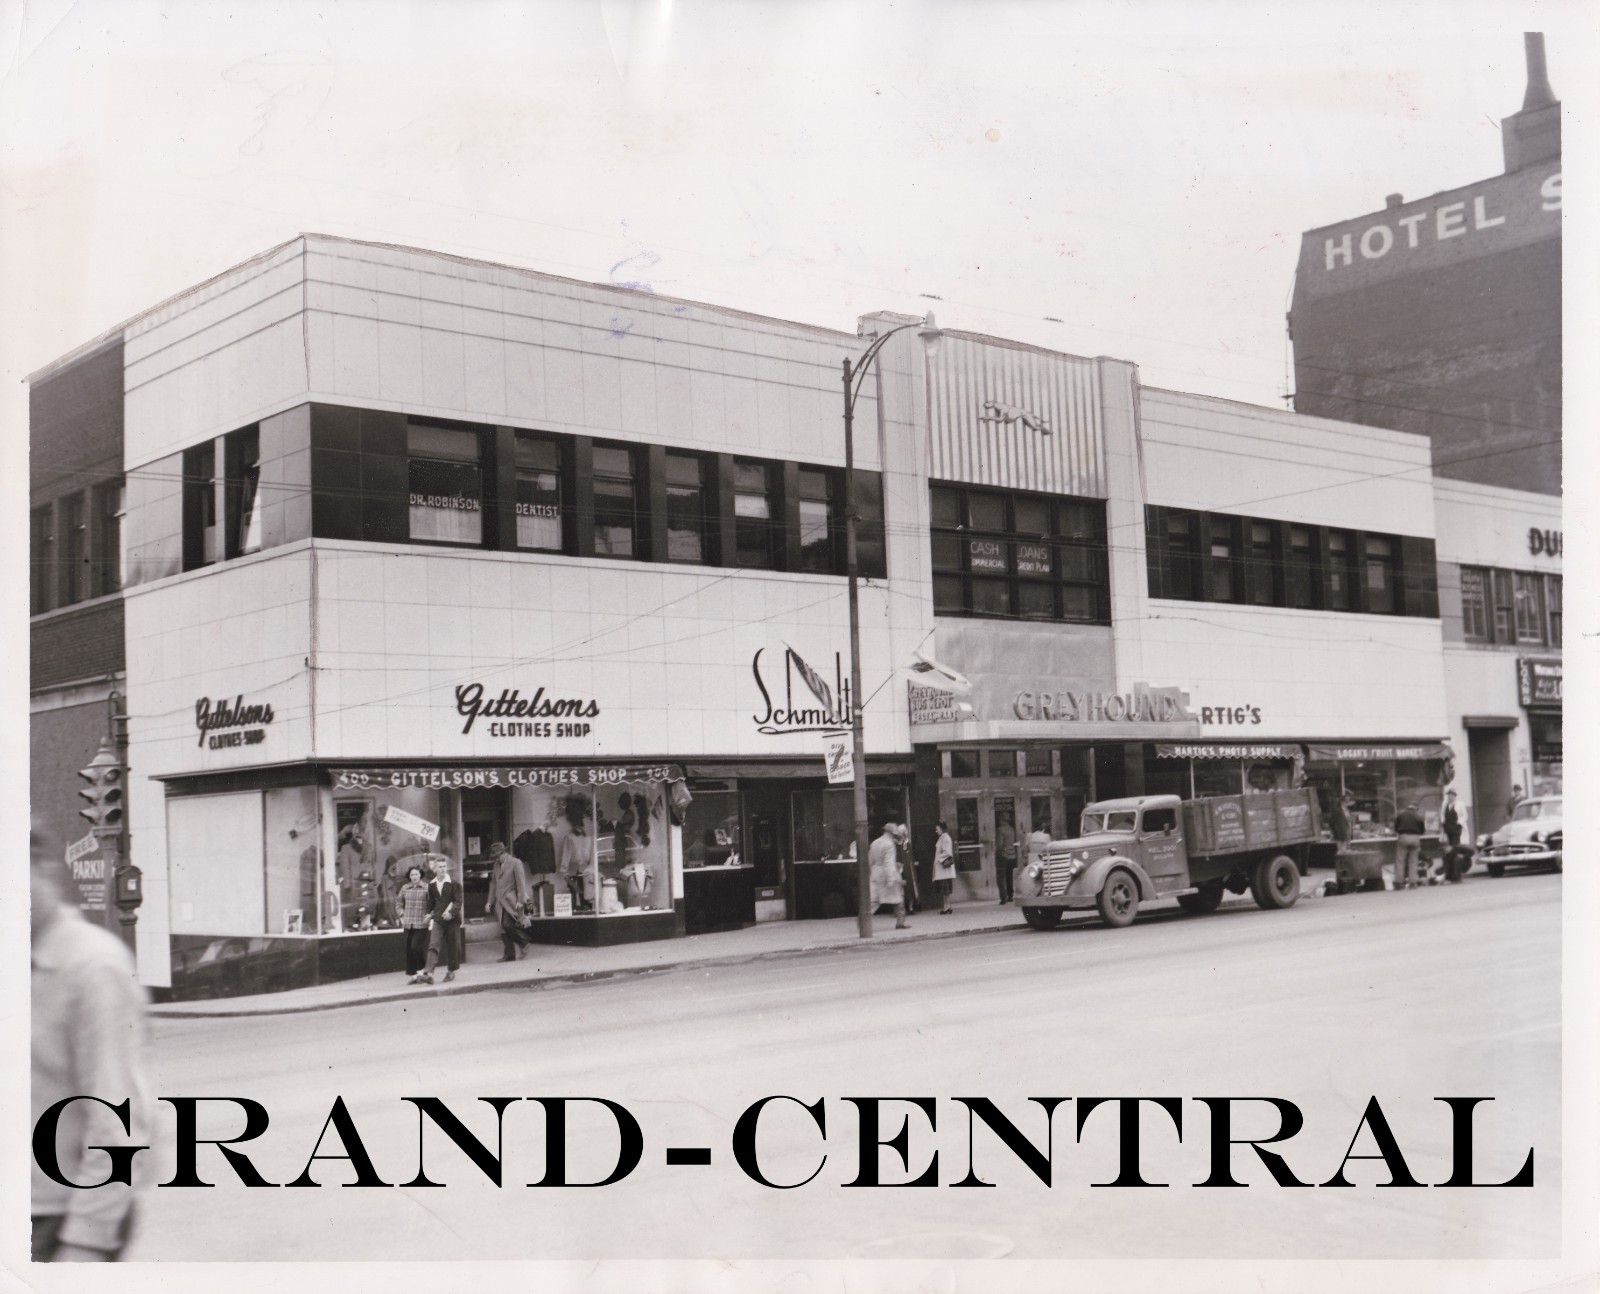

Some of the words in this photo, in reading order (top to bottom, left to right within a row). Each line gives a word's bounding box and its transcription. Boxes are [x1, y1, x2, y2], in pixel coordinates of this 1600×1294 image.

[1324, 196, 1505, 271] HOTEL
[409, 493, 427, 506] DR.
[427, 495, 480, 511] ROBINSON
[515, 502, 560, 518] DENTIST
[970, 541, 1000, 556] CASH
[1529, 527, 1562, 558] DU
[971, 558, 1006, 569] OMMERCIAL
[455, 682, 600, 735] Gittelsons
[1013, 690, 1176, 722] GREYHOUND
[1202, 703, 1262, 725] RTIG'S
[490, 722, 551, 737] CLOTHES
[556, 723, 591, 737] SHOP
[1219, 746, 1247, 756] PHOTO
[1250, 746, 1281, 756] SUPPLY
[339, 773, 370, 785] 400
[390, 770, 500, 786] GITTELSON'S
[508, 769, 579, 784] CLOTHES
[588, 768, 627, 781] SHOP
[73, 859, 116, 879] PARKI
